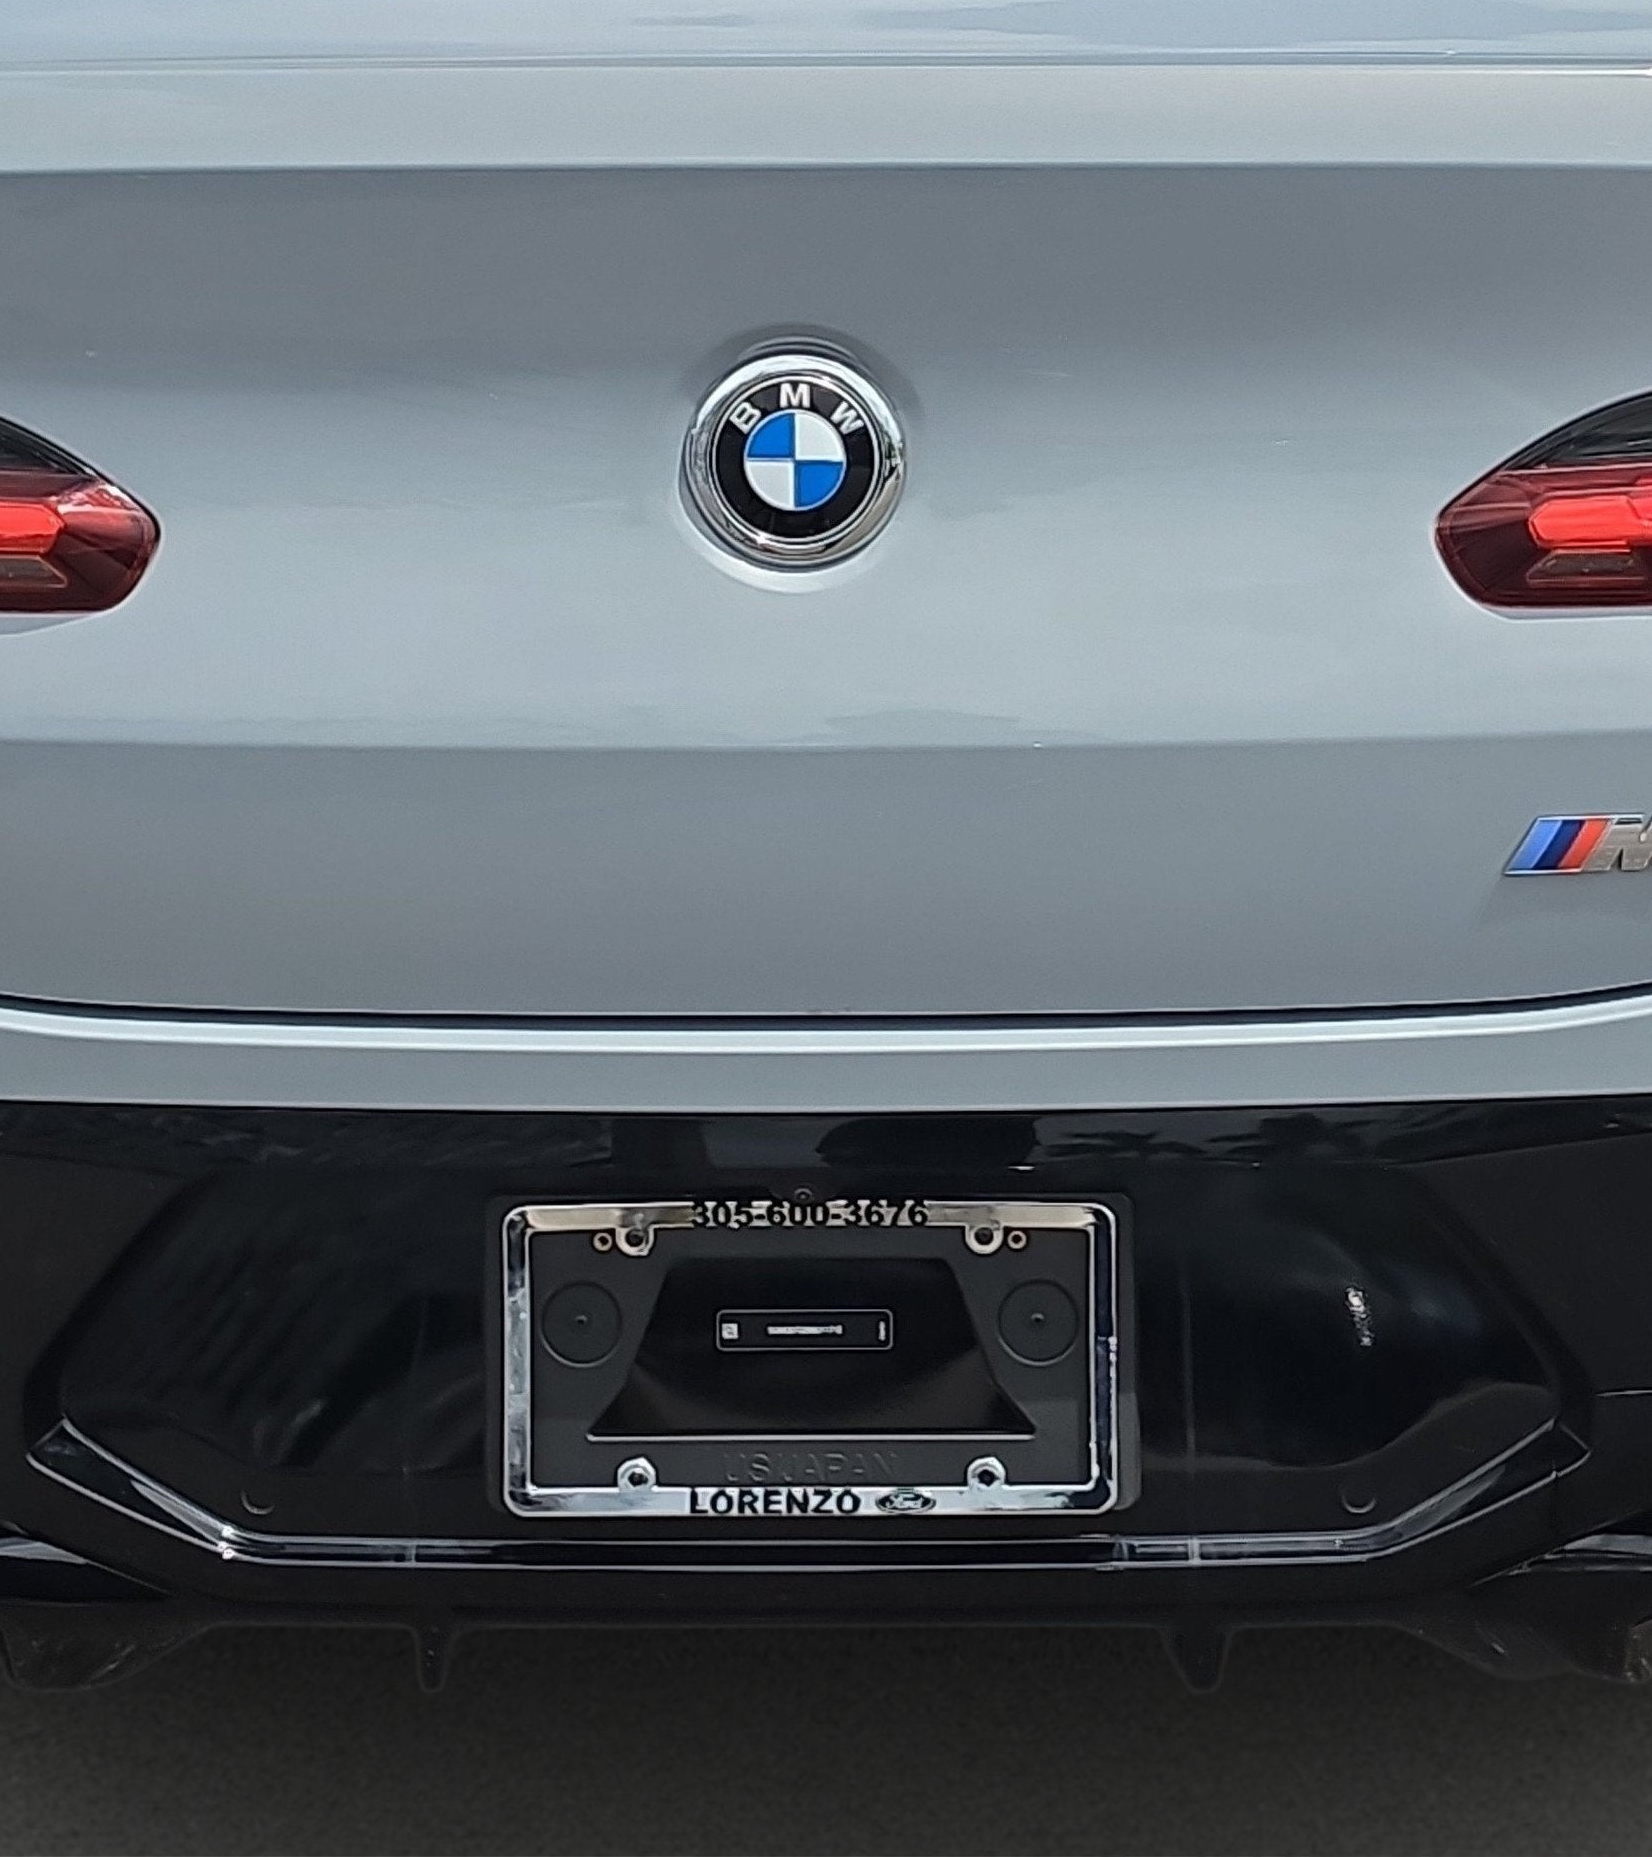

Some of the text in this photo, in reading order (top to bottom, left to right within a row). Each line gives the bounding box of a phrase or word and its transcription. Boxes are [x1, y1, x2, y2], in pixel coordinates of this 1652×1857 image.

[729, 381, 865, 436] BMW
[691, 1199, 930, 1229] 305-600-3676
[688, 1487, 862, 1515] LORENZO
